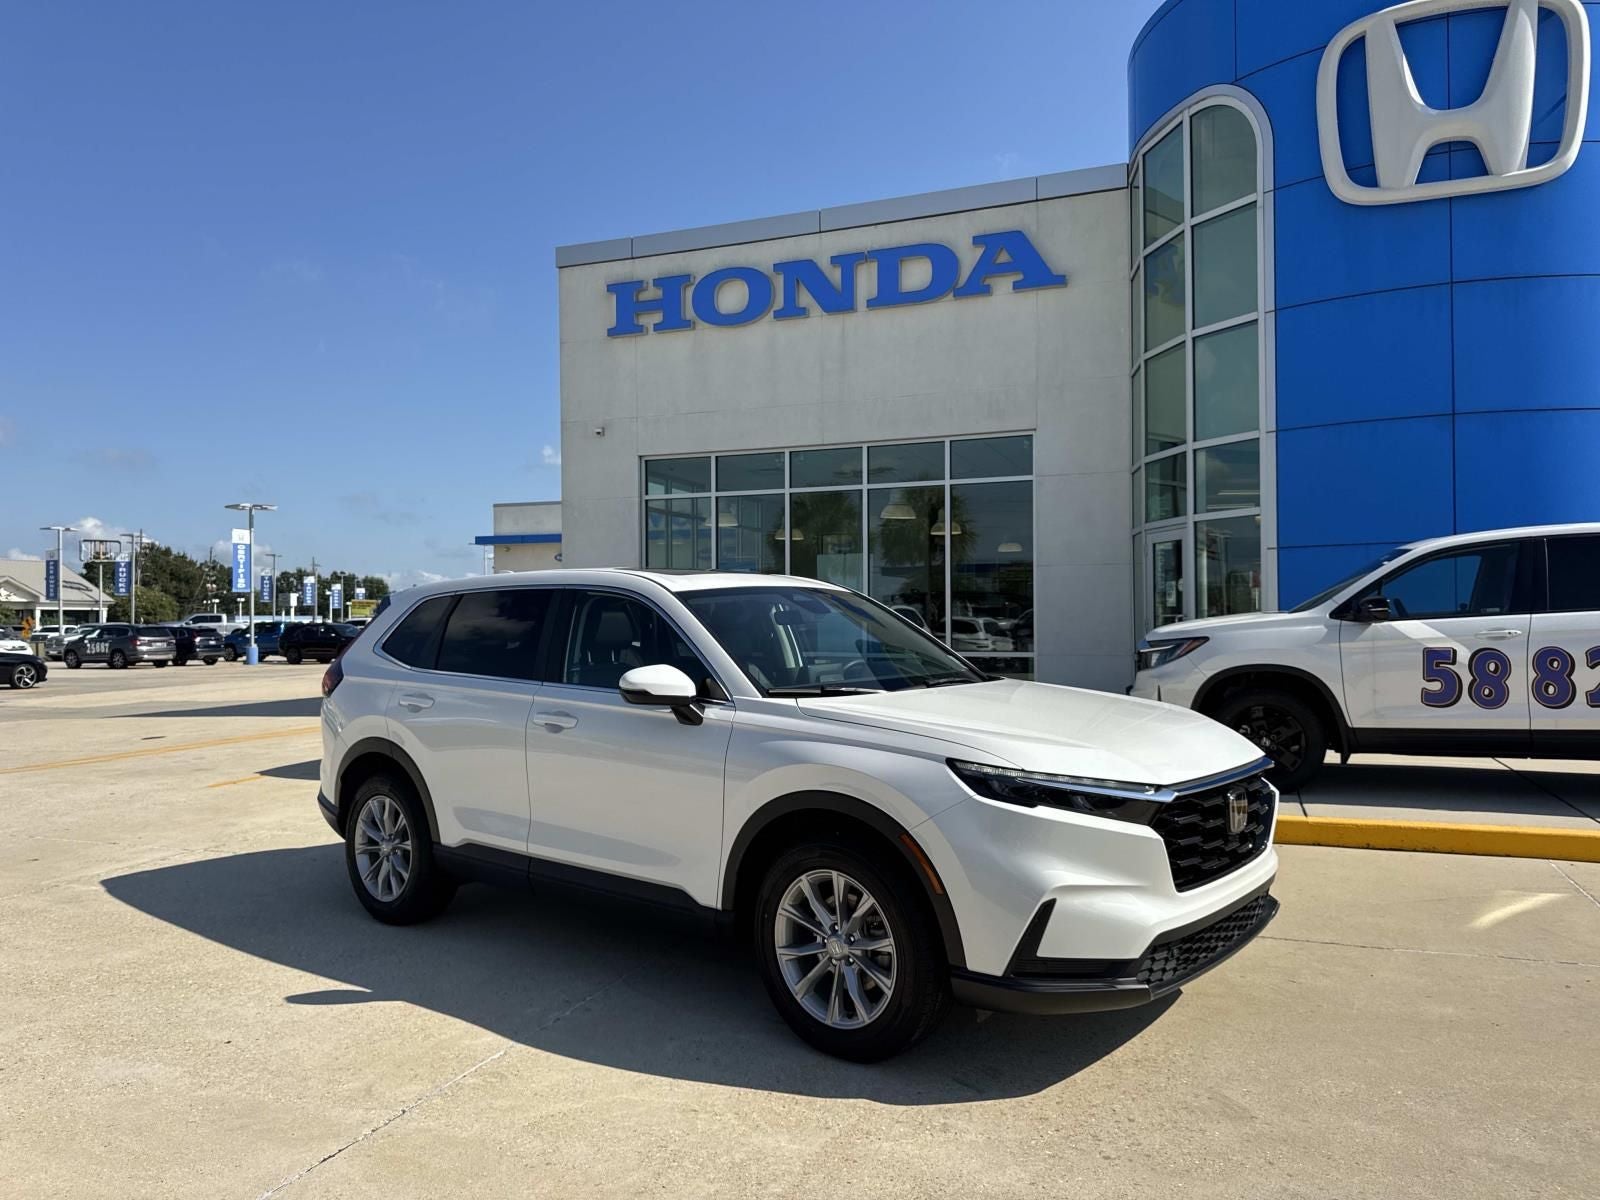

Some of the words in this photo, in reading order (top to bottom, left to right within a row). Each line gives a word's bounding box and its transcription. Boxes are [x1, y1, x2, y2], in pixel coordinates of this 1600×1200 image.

[606, 229, 1068, 338] HONDA
[118, 562, 126, 593] TRUCKS
[237, 544, 246, 589] CERTIFIED
